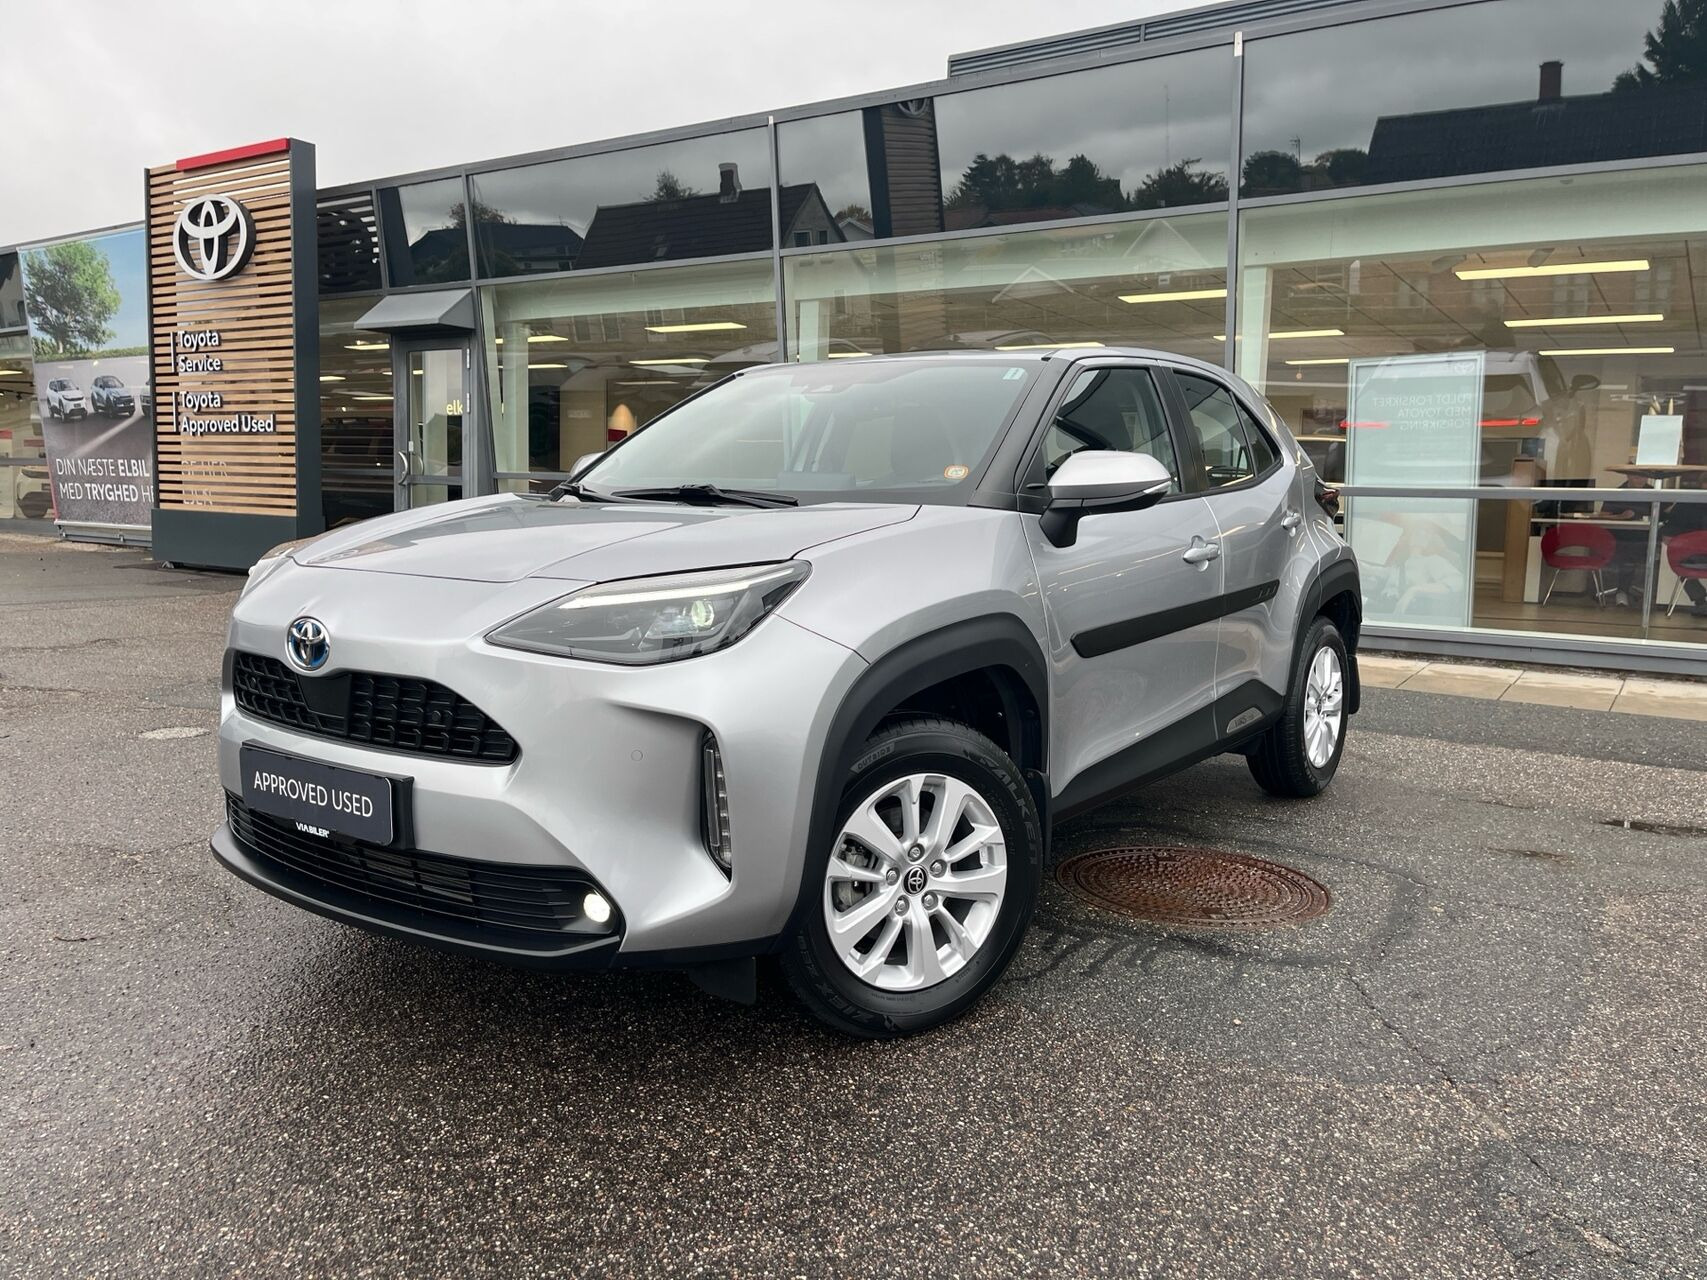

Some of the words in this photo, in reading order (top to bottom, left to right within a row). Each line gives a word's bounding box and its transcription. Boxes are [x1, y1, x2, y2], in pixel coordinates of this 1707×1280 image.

[178, 330, 219, 352] Toyota
[179, 355, 221, 372] Service
[180, 391, 221, 412] Toyota
[181, 414, 239, 436] Approved
[241, 414, 274, 433] Used
[56, 458, 76, 476] DIN
[78, 458, 116, 477] NÆSTE
[118, 459, 150, 477] ELBIL
[59, 482, 83, 500] MED
[84, 482, 138, 503] TRYGHED
[253, 770, 328, 807] APPROVED
[331, 788, 373, 818] USED
